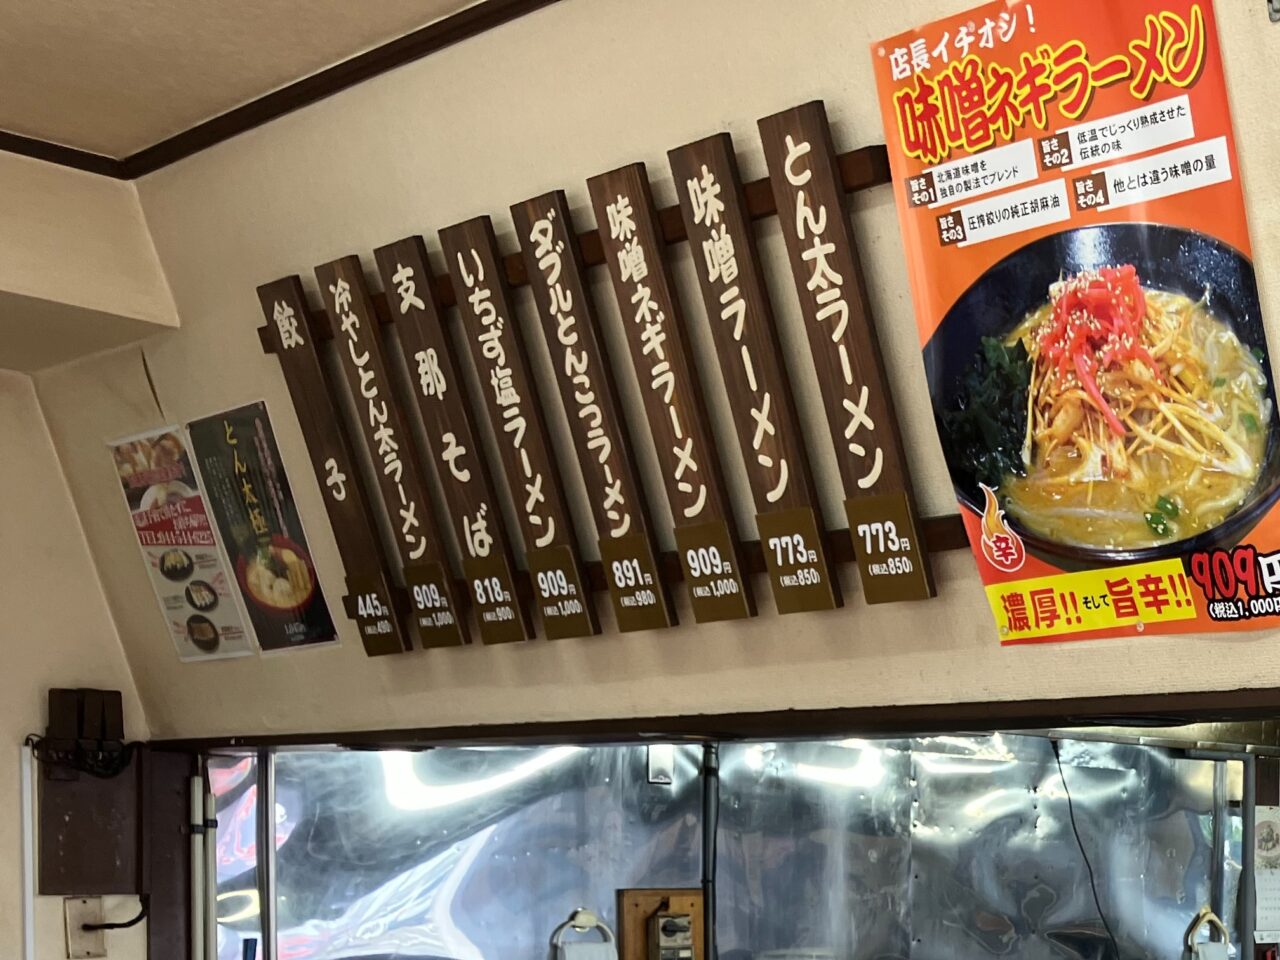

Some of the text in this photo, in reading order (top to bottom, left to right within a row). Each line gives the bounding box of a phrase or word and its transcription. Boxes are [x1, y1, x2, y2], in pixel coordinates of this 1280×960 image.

[892, 4, 1205, 162] 味噌ネギラーメン
[1077, 104, 1186, 145] 低温でじっくり熟成させた
[1041, 137, 1059, 154] 旨さ
[1042, 149, 1070, 166] その2
[1079, 139, 1123, 160] 伝統の味
[936, 162, 987, 179] 北海道味噌を
[939, 165, 1019, 198] 独自の製法でブレンド
[1075, 178, 1094, 194] 旨さ
[1113, 155, 1216, 194] 他とは違う味噌の量
[910, 187, 938, 205] その1
[1077, 190, 1106, 208] その4
[939, 215, 955, 230] 旨さ
[941, 226, 964, 244] その3
[784, 134, 884, 489] とん太ラーメン
[686, 164, 789, 503] 味噌ラーメン
[606, 194, 707, 518] 味噌ネギラーメン
[529, 207, 631, 538] ダブルとんこつラーメン
[392, 263, 494, 557] 支那そば
[457, 248, 555, 548] いちず塩ラーメン
[329, 278, 427, 560] 冷やしとん太ラーメン
[223, 420, 268, 534] とん太極
[768, 533, 818, 566] 773円
[857, 521, 910, 553] 773円
[991, 535, 1017, 564] 辛
[611, 558, 653, 588] 891円
[687, 546, 732, 578] 909円
[868, 556, 913, 576] (税込850)
[413, 583, 448, 609] 909円
[474, 577, 511, 604] 818円
[537, 569, 576, 598] 909円
[357, 593, 389, 618] 445円
[1000, 572, 1192, 633] 濃厚!! そして 旨辛!!
